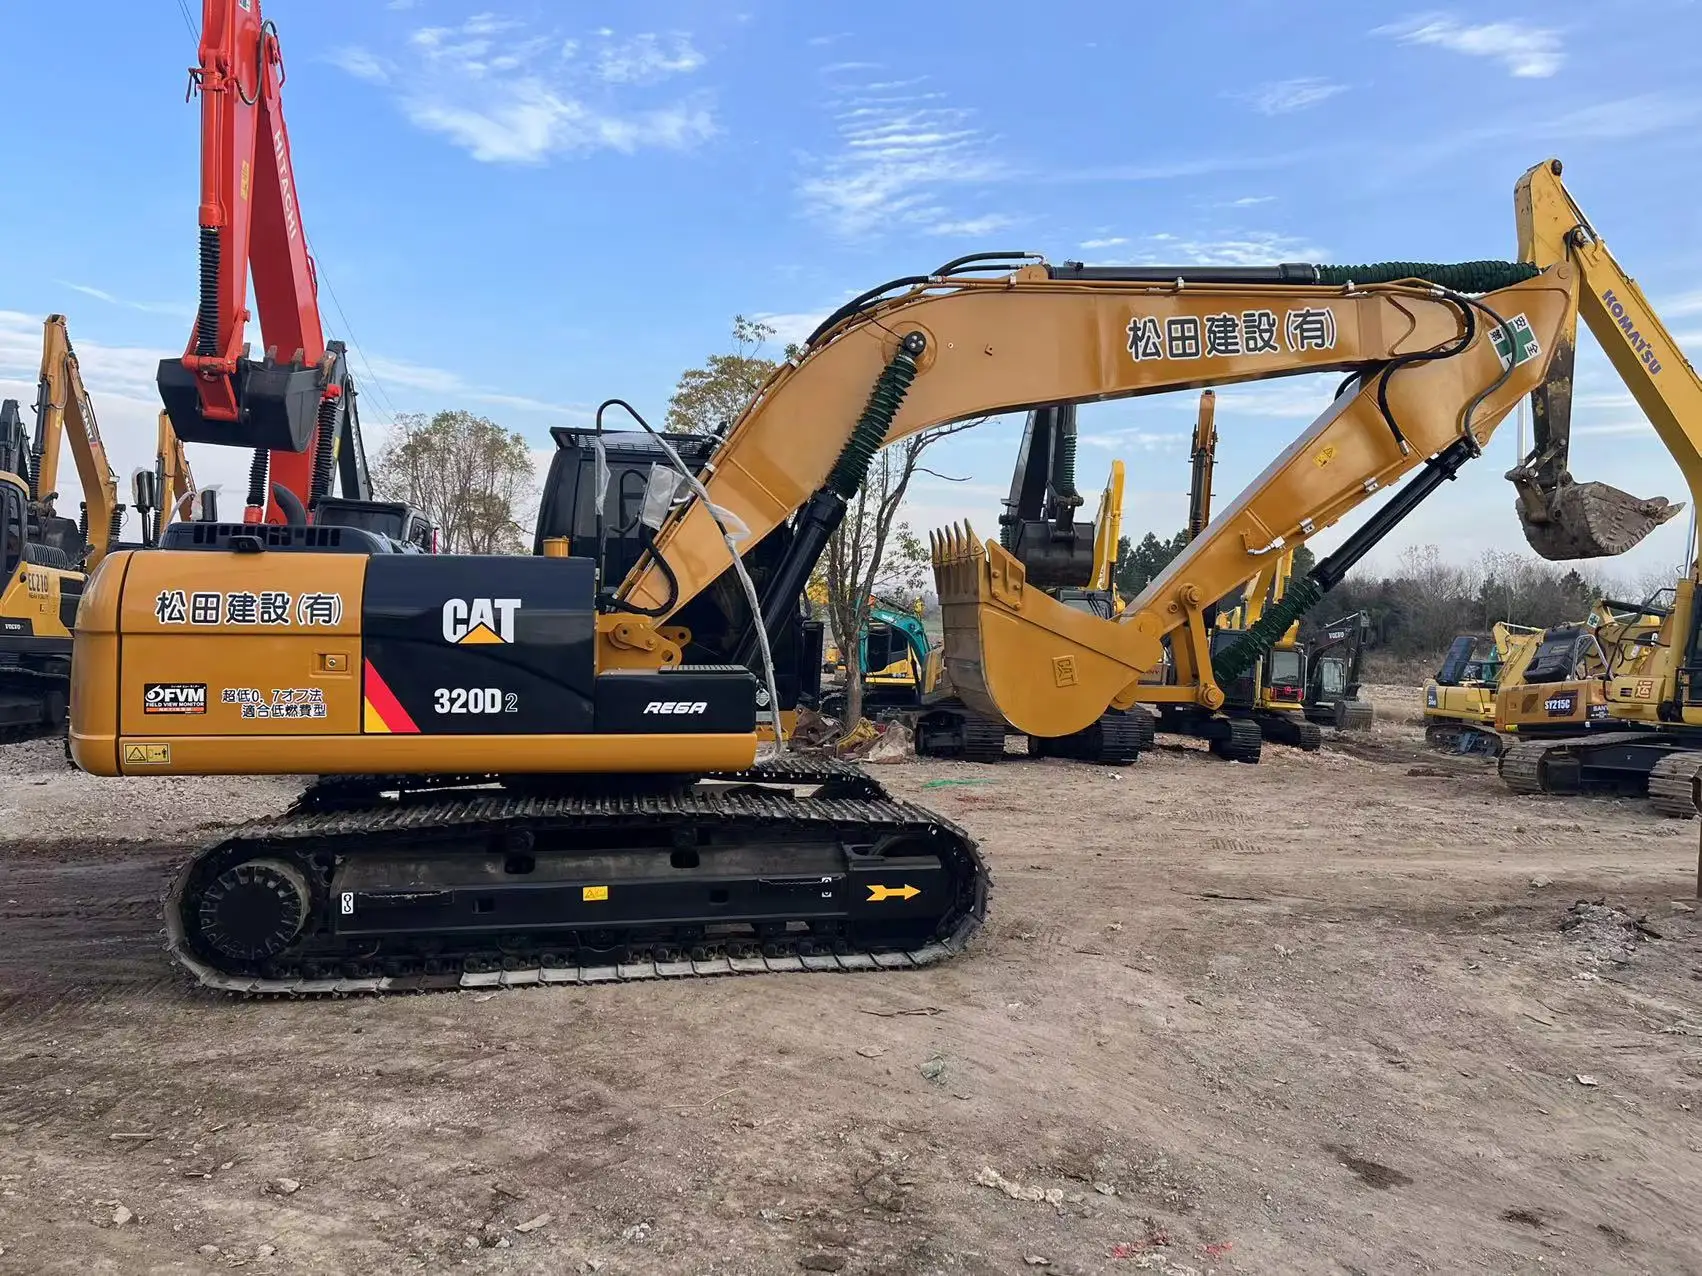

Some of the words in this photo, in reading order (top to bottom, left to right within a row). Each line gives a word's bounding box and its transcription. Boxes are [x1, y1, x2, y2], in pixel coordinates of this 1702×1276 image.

[275, 130, 297, 239] HITACHI
[1602, 289, 1662, 375] KOMATSU
[442, 598, 522, 644] CAT
[1057, 659, 1075, 682] CAT
[164, 688, 205, 702] FVM
[1544, 699, 1570, 710] SY215C
